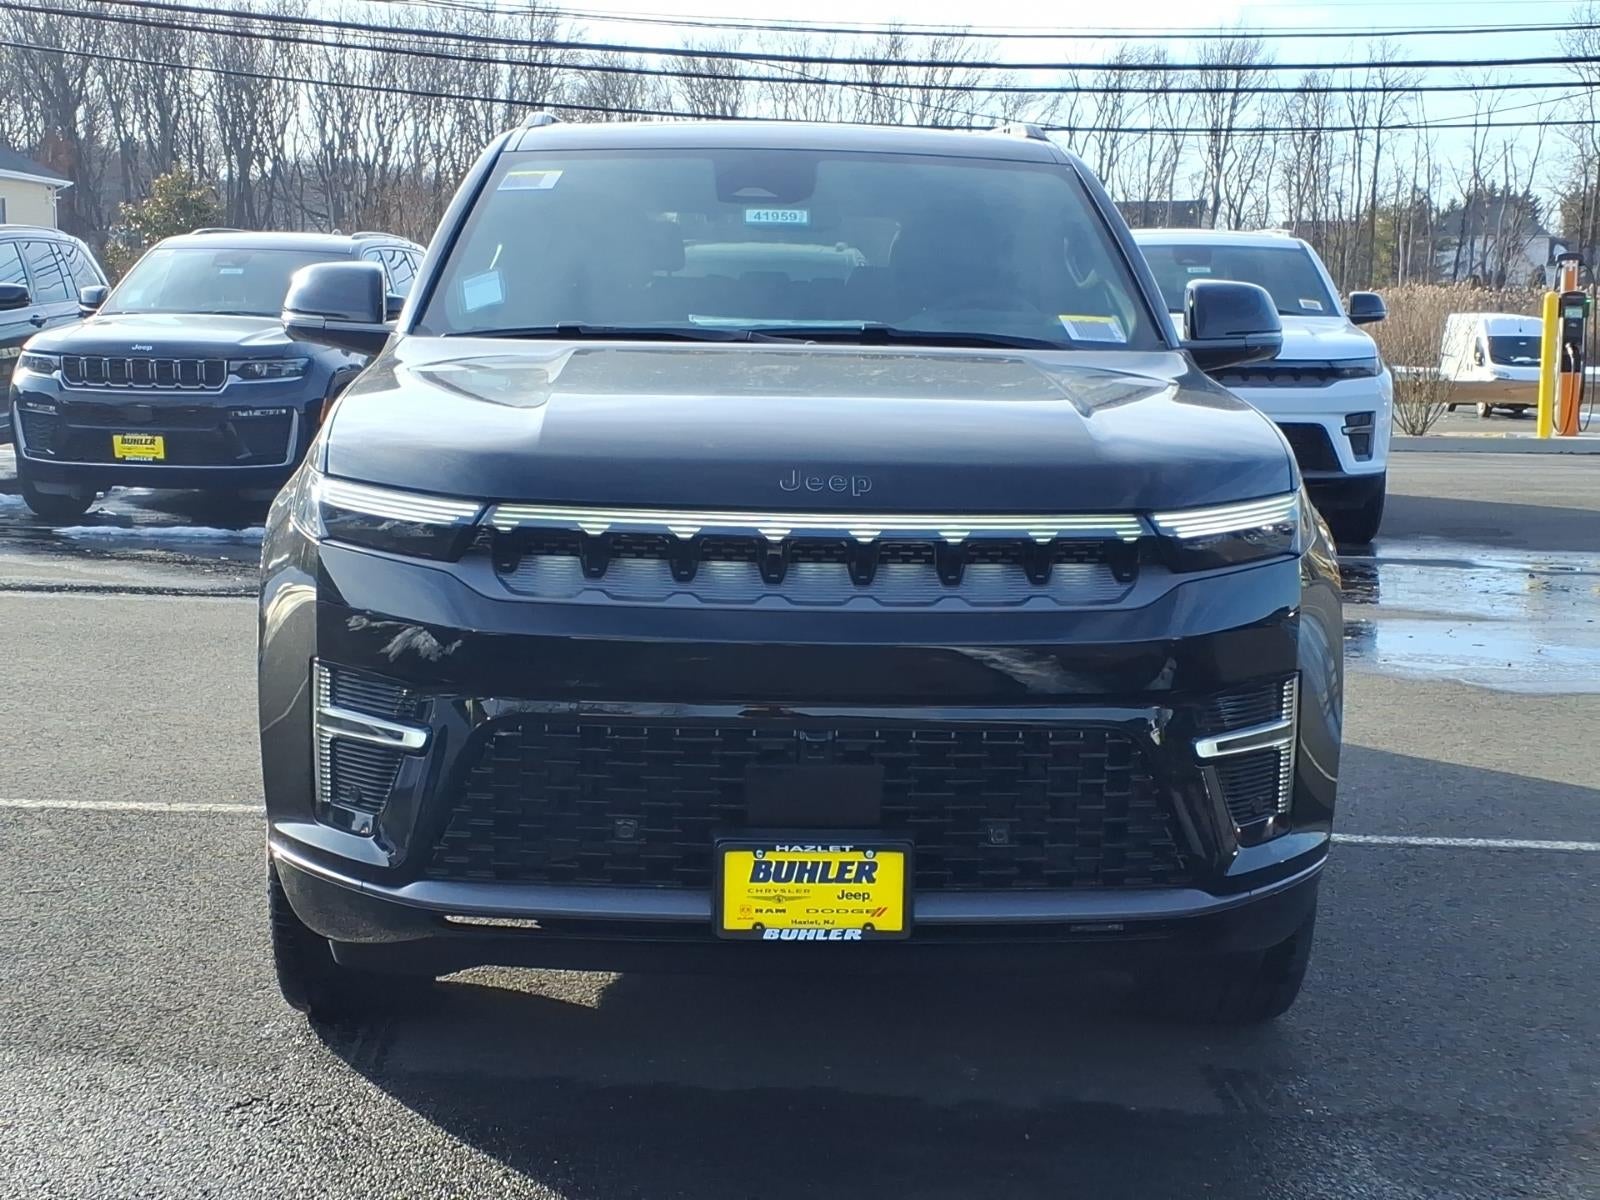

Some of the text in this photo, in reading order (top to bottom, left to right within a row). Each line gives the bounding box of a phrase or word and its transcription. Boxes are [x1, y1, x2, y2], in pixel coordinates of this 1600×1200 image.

[753, 210, 798, 222] 41959
[131, 344, 153, 352] Jeep
[779, 468, 872, 497] Jeep
[775, 844, 854, 853] HAZLET
[749, 859, 879, 885] BUHLER
[837, 889, 871, 902] Jeep
[762, 927, 862, 941] BUHLER
